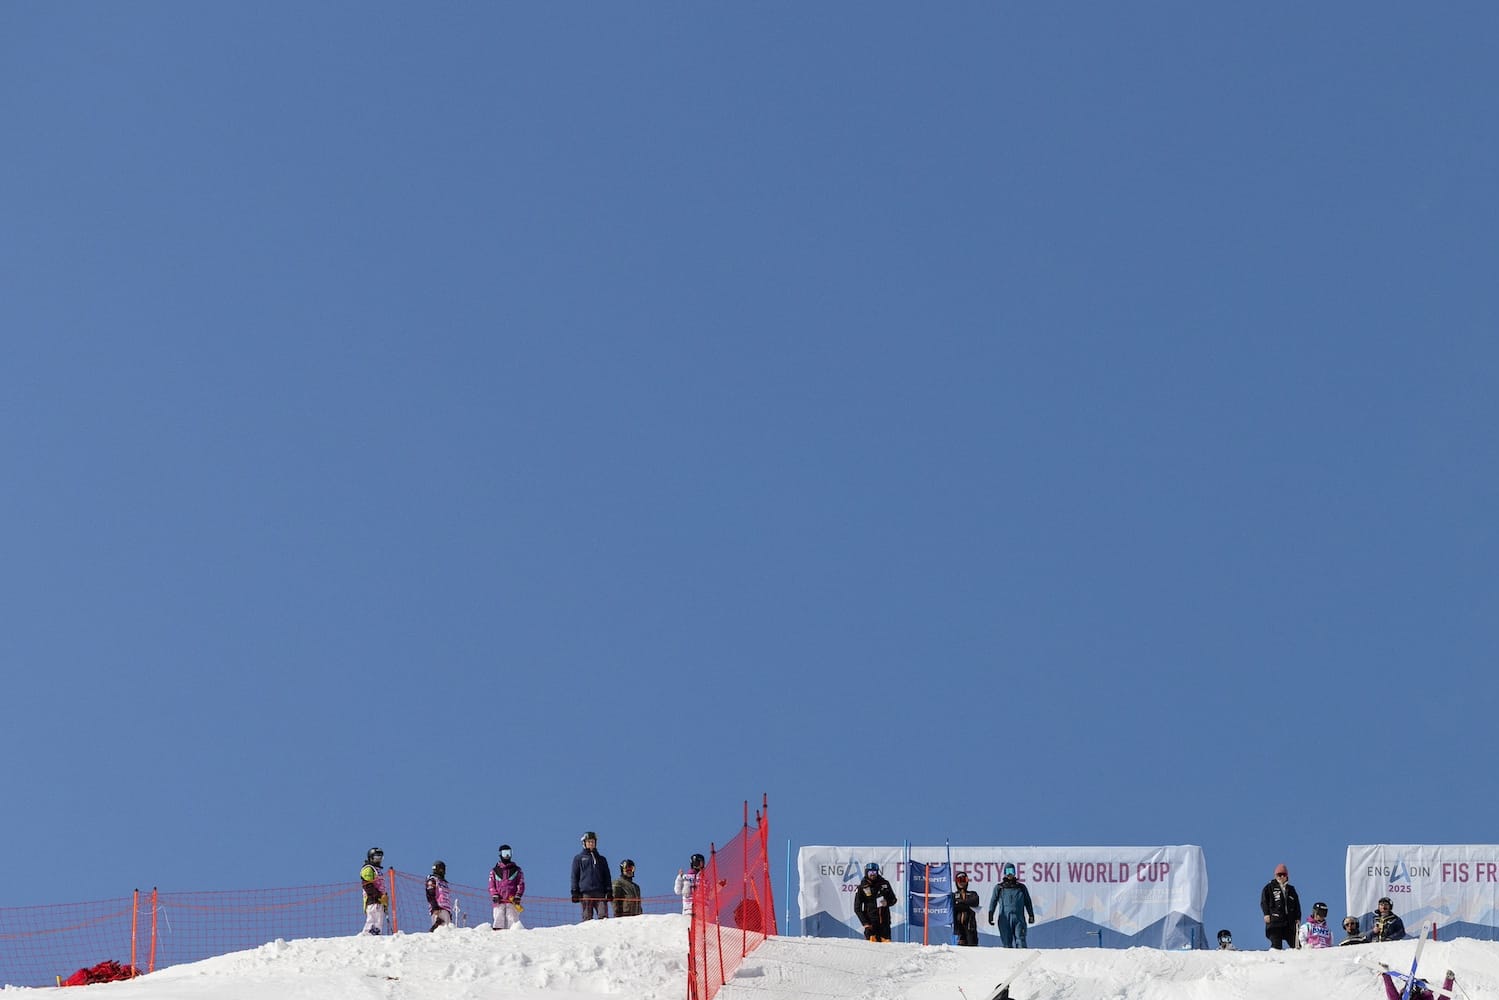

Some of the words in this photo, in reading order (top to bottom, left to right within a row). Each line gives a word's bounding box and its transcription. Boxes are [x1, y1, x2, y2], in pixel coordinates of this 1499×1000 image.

[821, 857, 884, 882] ENGAN
[929, 862, 1026, 882] EESTYE
[1032, 862, 1060, 882] SKI
[1068, 862, 1129, 882] WORLD
[1136, 862, 1170, 882] CUP
[1367, 853, 1430, 883] ENGADIN
[1442, 862, 1469, 883] FIS
[1388, 884, 1411, 893] 2025
